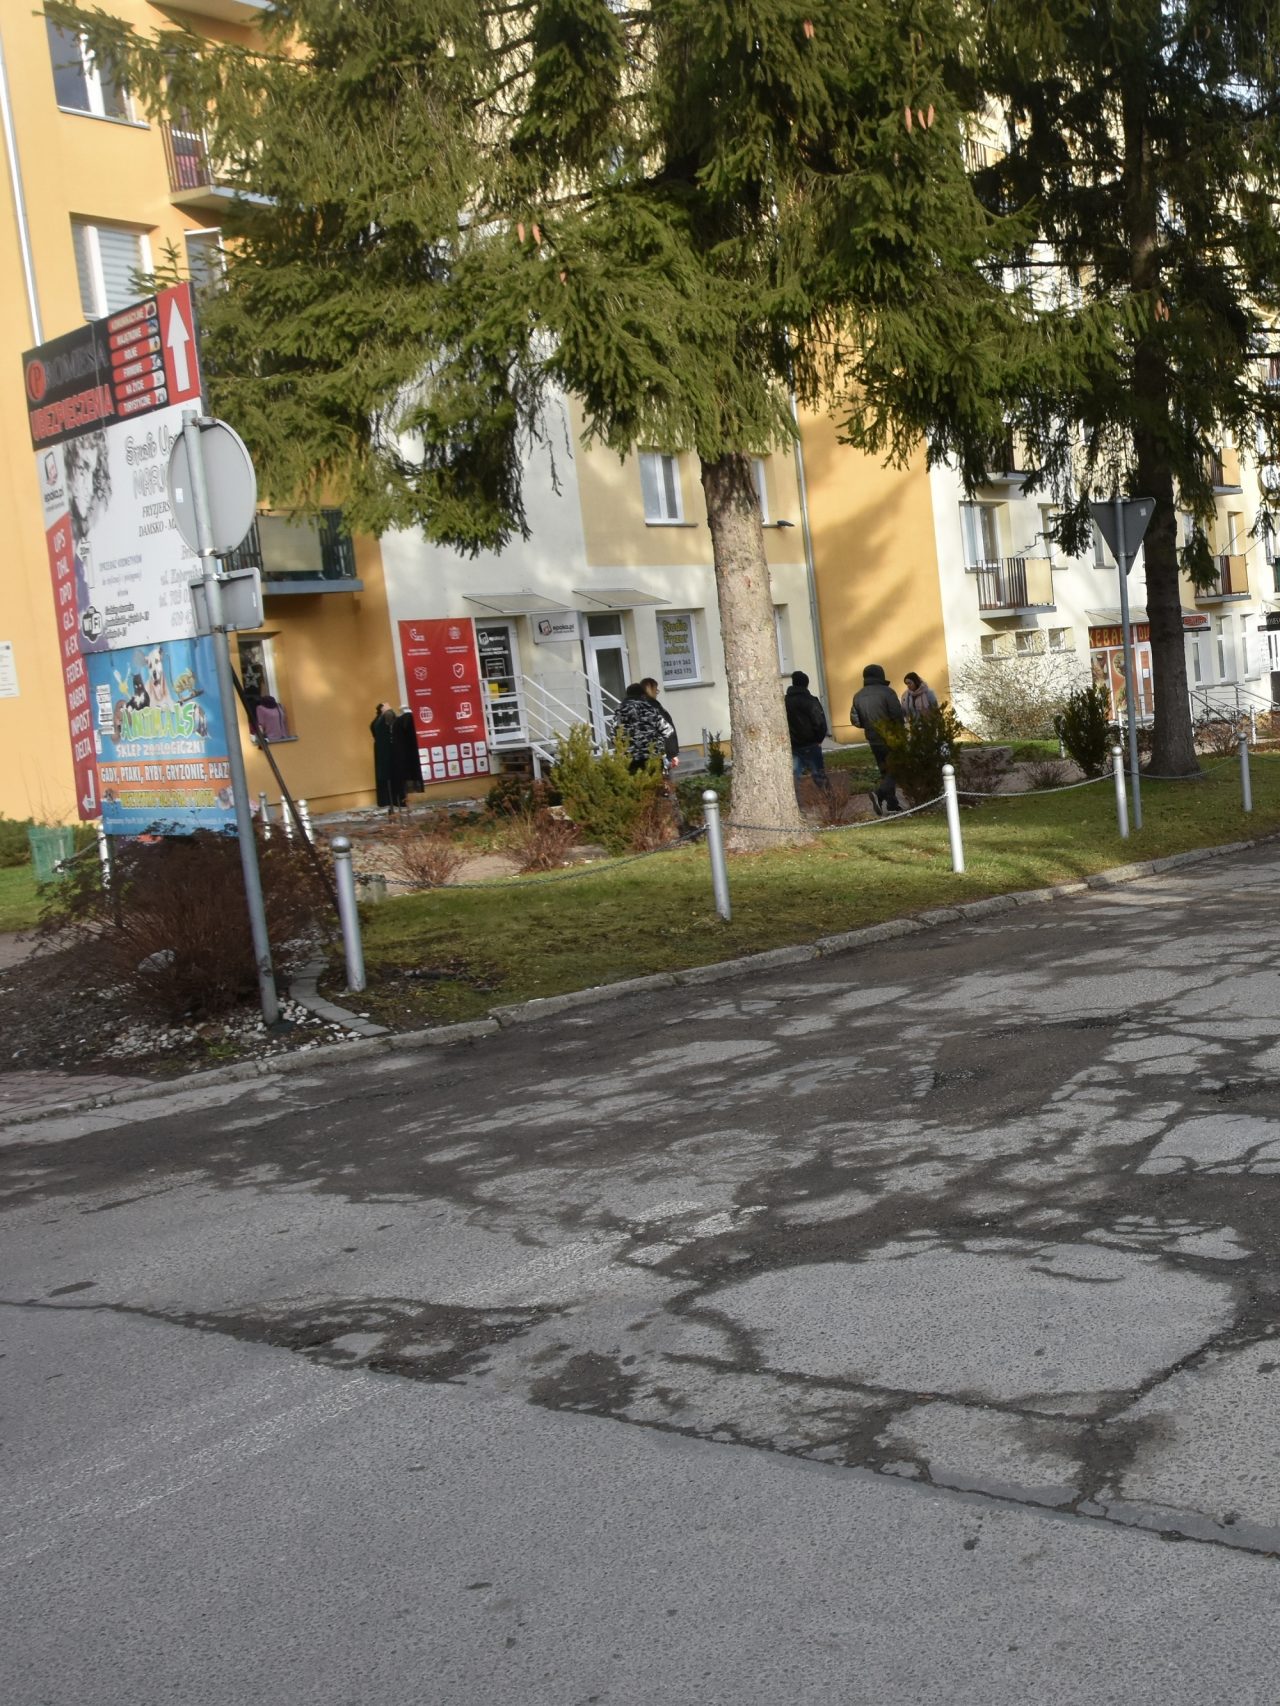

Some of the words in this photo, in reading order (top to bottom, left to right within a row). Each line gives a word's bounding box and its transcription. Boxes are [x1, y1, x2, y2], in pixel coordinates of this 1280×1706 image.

[30, 384, 116, 441] UBEZPIECZENIA
[143, 500, 171, 519] FRYZJERS
[53, 528, 66, 553] UPS
[56, 561, 70, 580] DHL
[59, 581, 72, 606] DPD
[63, 607, 75, 631] GLS
[65, 632, 79, 658] K-EX
[65, 657, 84, 684] FEDEX
[68, 684, 87, 711] RABEN
[70, 708, 91, 738] INPOST
[120, 701, 197, 742] ANIMALS
[75, 736, 92, 762] DELTA
[116, 743, 142, 758] SKLEP
[143, 740, 206, 756] ZOOLOGICZNY
[101, 766, 120, 784] GADY,
[120, 765, 144, 784] PTAKI,
[144, 763, 166, 783] RYBY,
[166, 761, 208, 782] GRYZONIE,
[208, 760, 231, 779] PŁAZ
